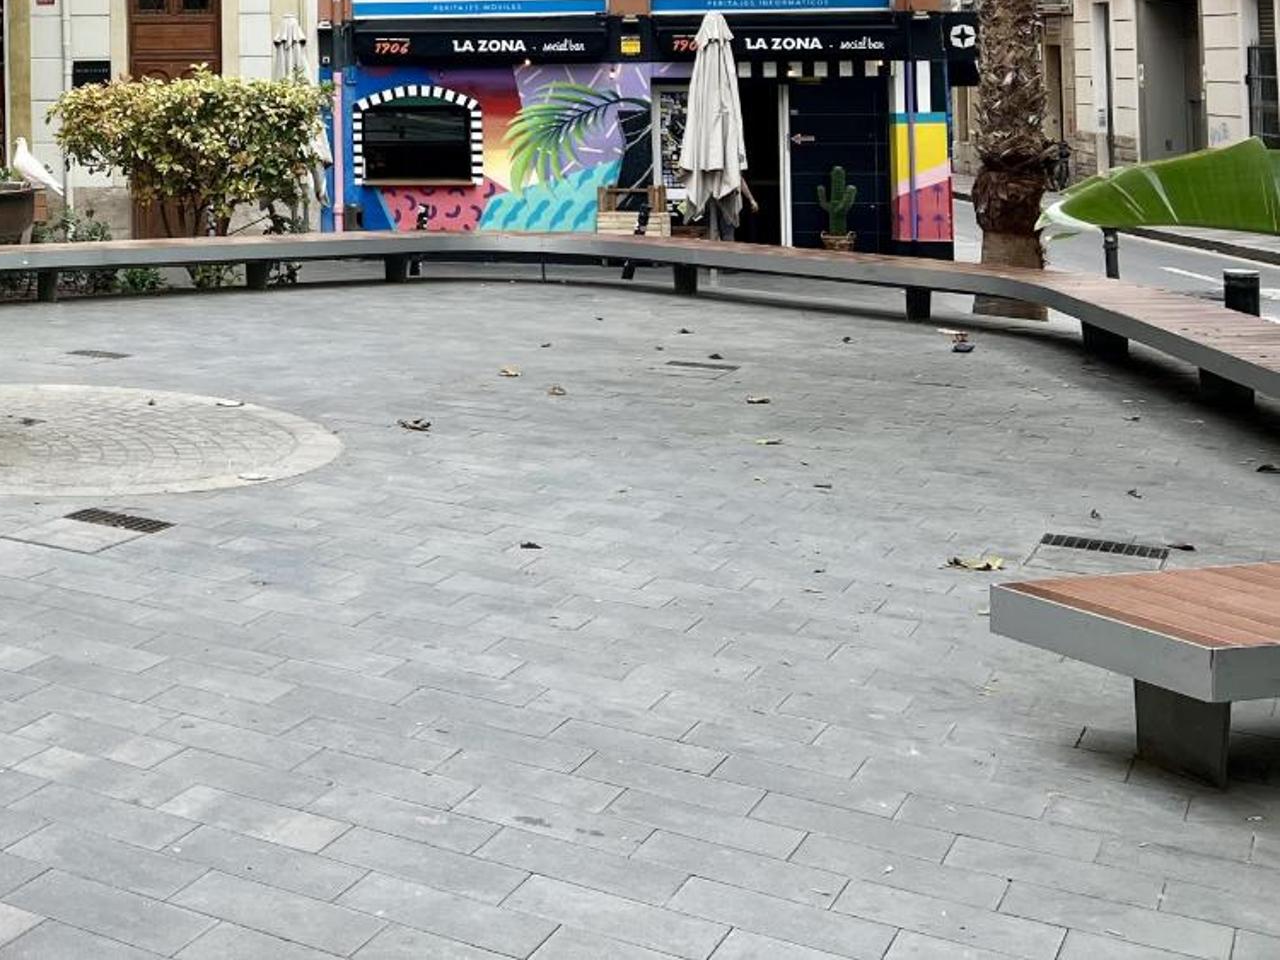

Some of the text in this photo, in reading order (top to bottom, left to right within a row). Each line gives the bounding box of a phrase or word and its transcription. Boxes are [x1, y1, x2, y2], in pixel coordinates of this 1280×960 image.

[375, 42, 410, 55] 1906
[452, 39, 474, 53] LA
[477, 39, 527, 53] ZONA
[542, 37, 568, 51] social
[569, 39, 585, 51] bar
[672, 39, 699, 52] 190
[745, 38, 769, 50] LA
[771, 37, 823, 50] ZONA
[839, 36, 867, 50] social
[868, 36, 885, 50] bar
